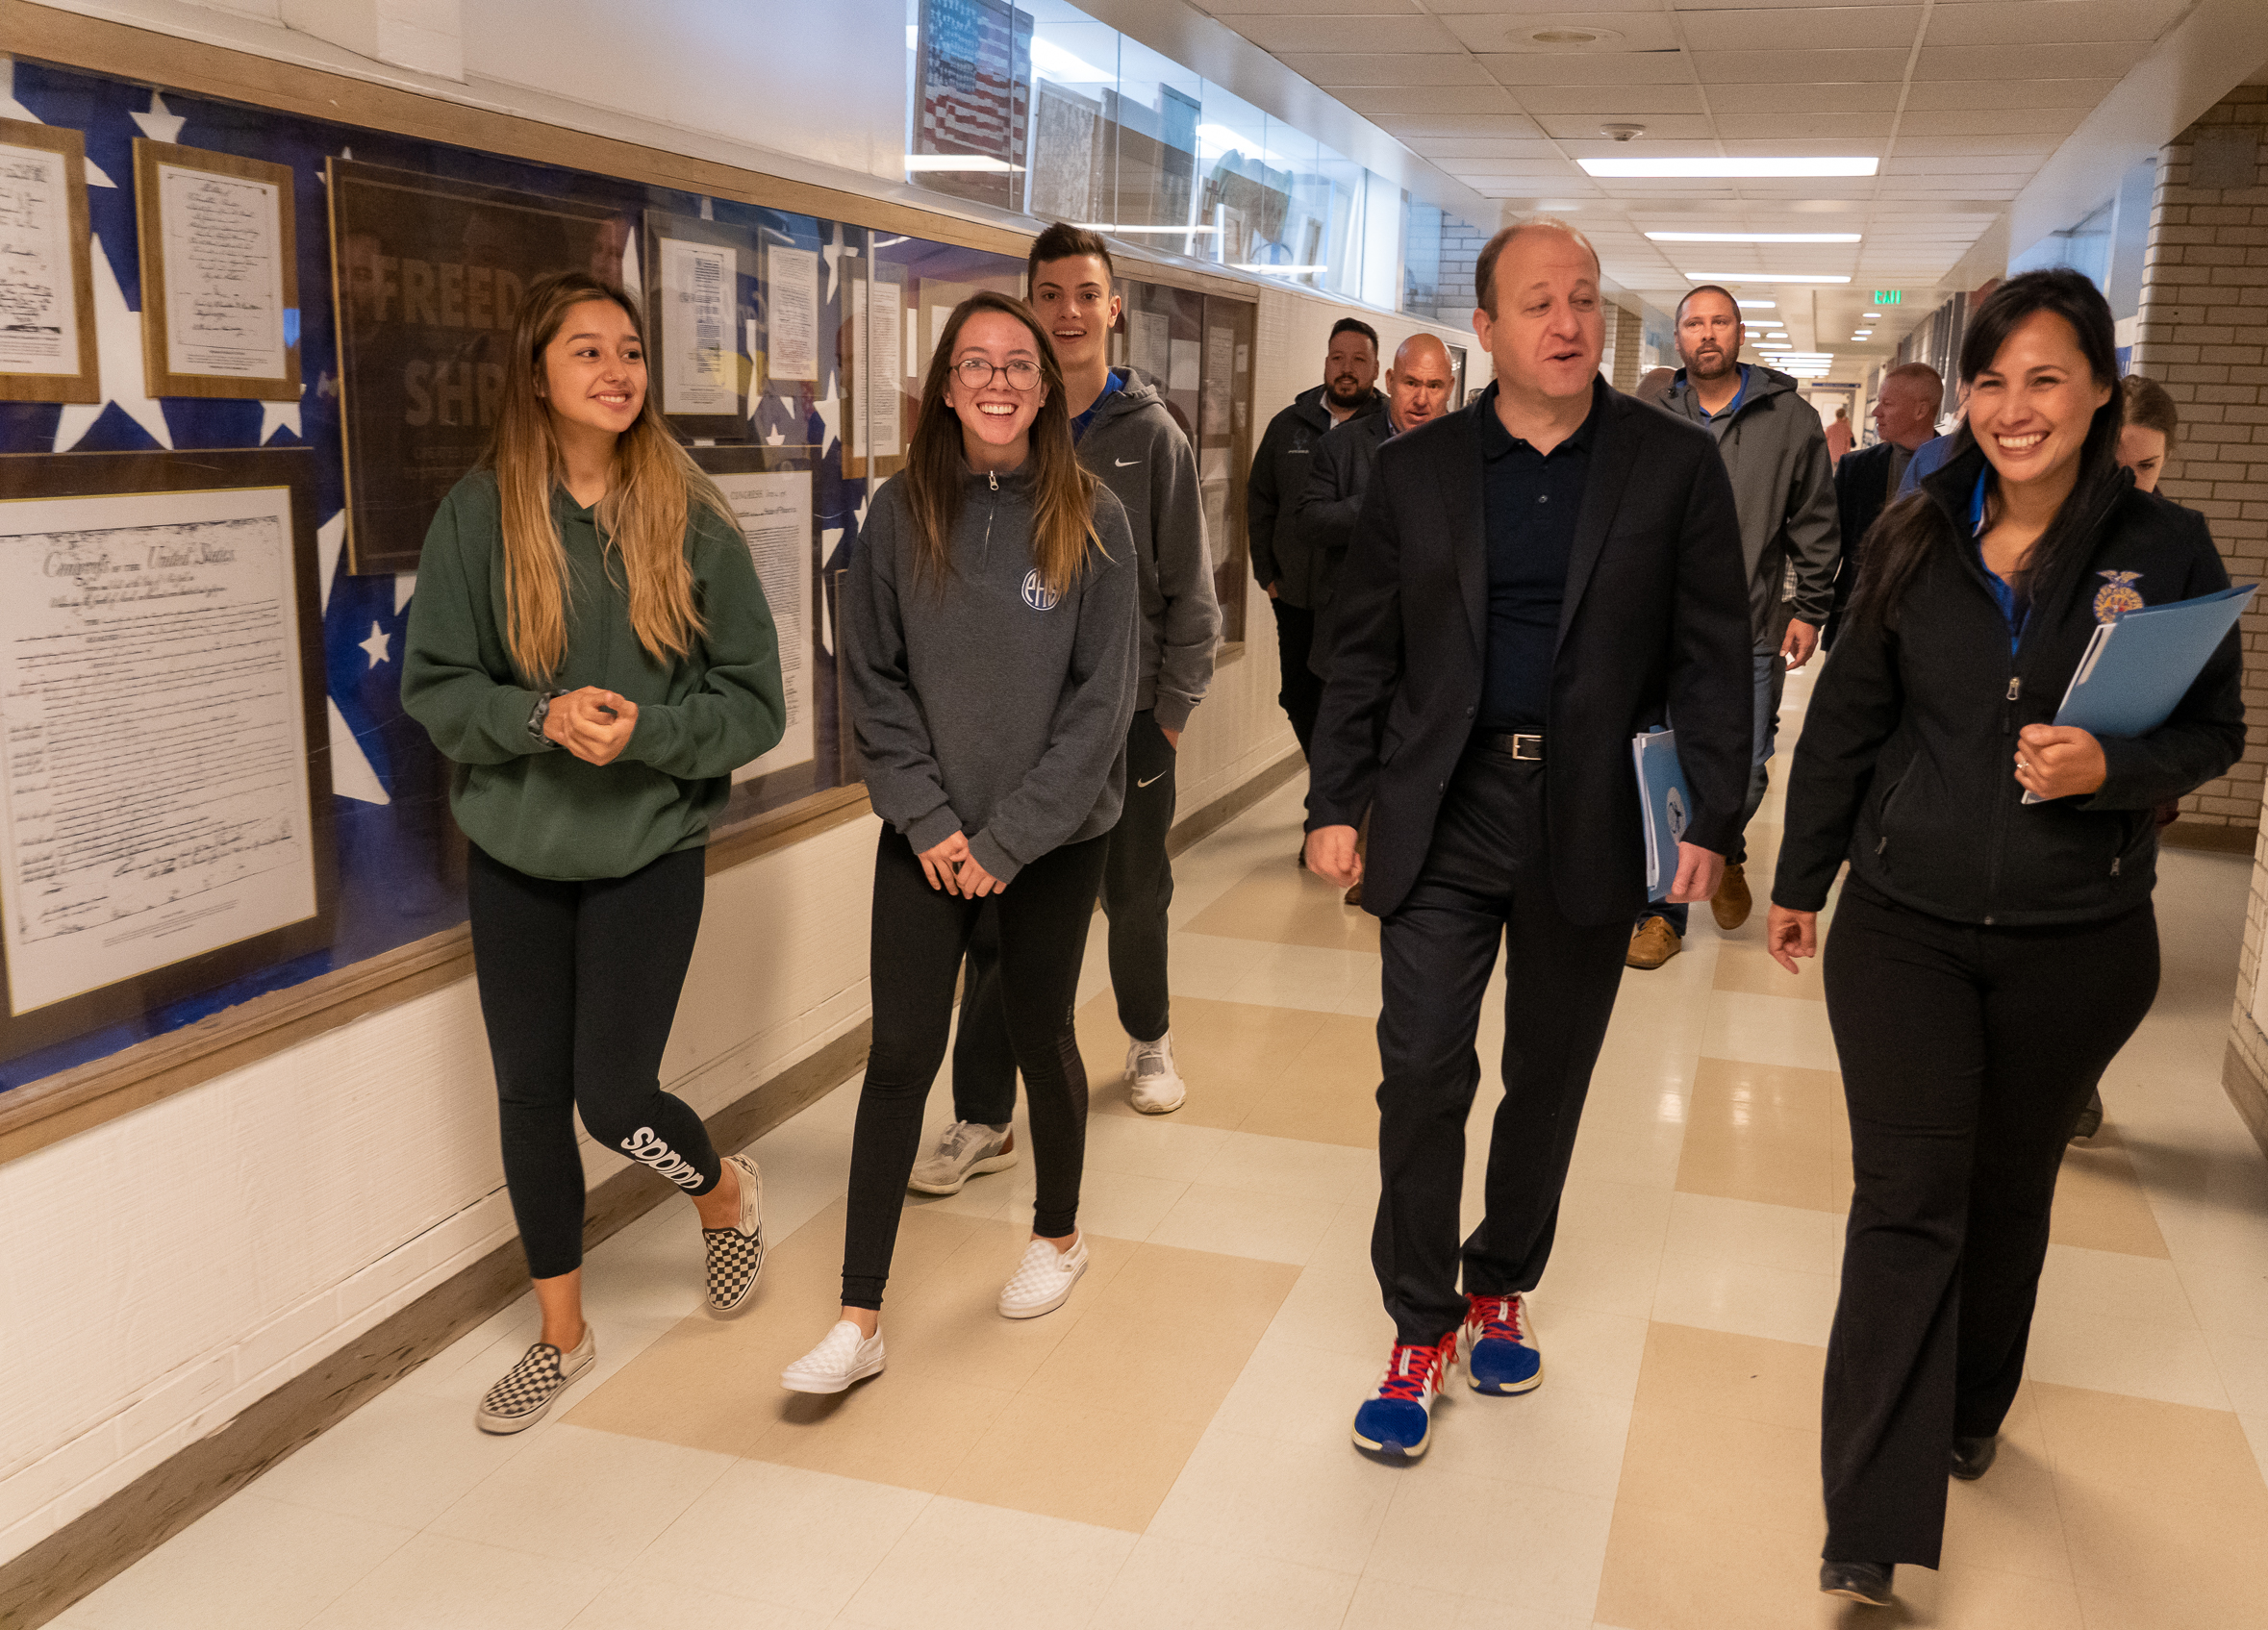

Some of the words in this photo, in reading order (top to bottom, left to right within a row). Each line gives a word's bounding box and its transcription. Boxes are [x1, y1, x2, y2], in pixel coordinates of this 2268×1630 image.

[372, 254, 548, 332] FREED
[404, 359, 509, 427] SHR
[620, 1126, 704, 1189] adidas
